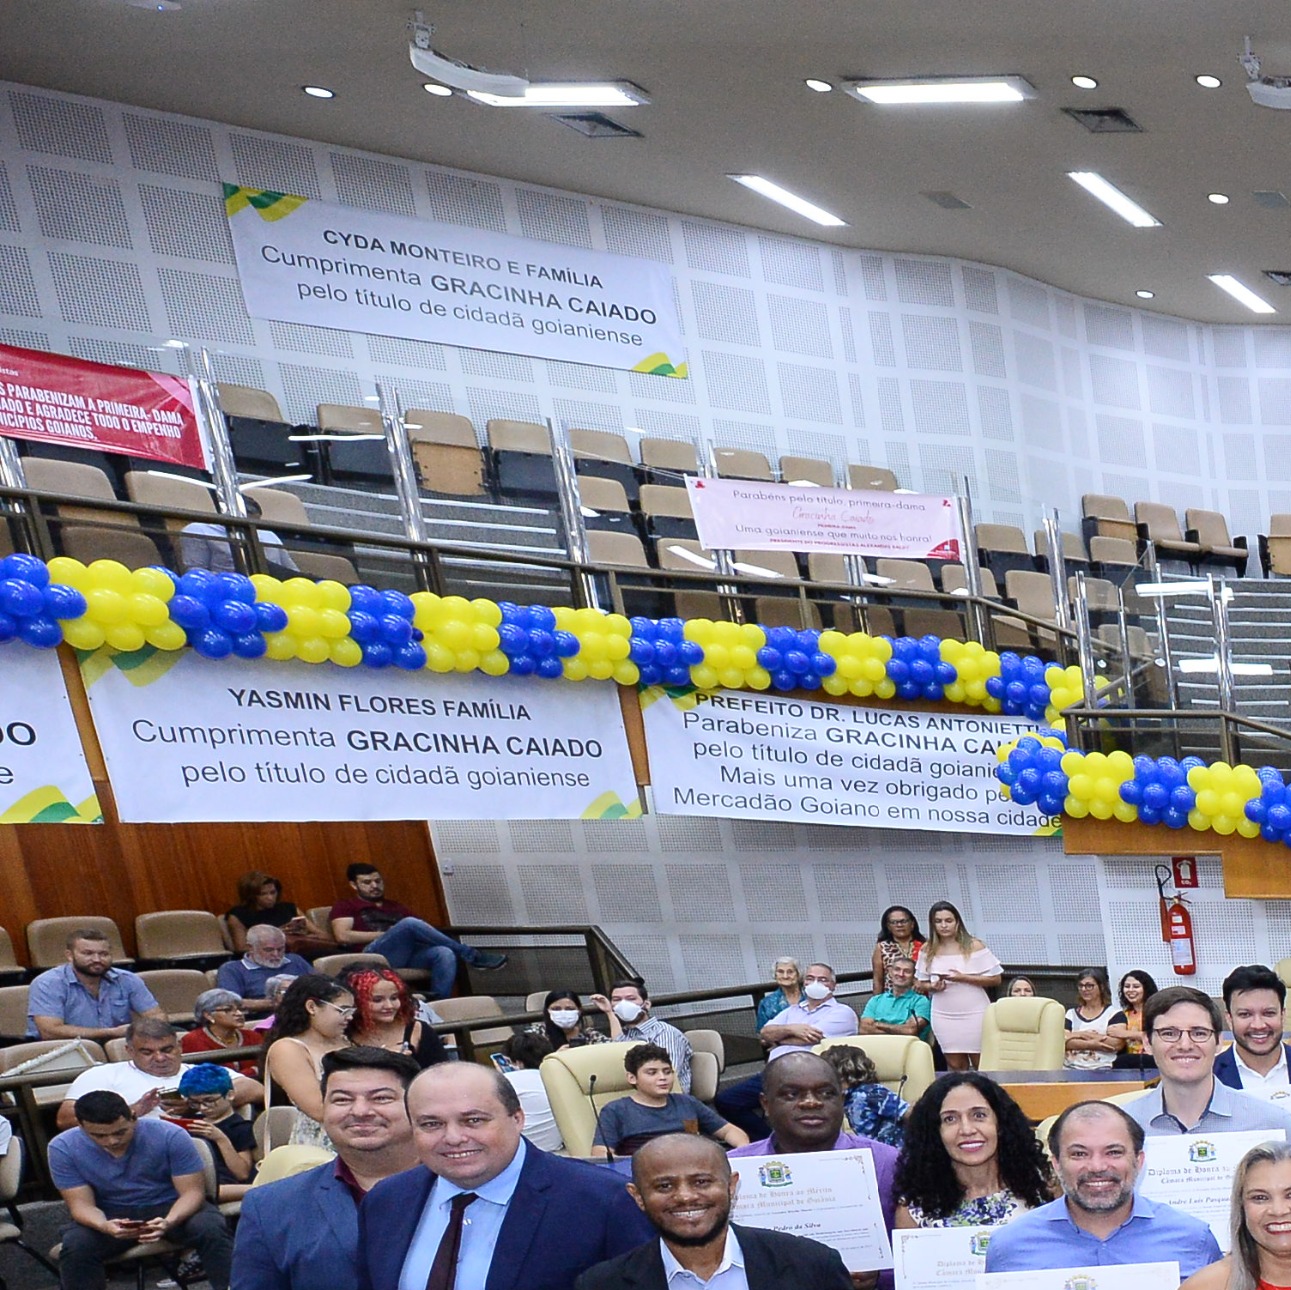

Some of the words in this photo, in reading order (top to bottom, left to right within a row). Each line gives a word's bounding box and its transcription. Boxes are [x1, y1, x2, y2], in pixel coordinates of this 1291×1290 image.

[323, 229, 384, 254] CYDA
[390, 241, 500, 271] MONTEIRO
[508, 261, 521, 275] E
[526, 263, 603, 288] FAMÍLIA
[261, 244, 421, 287] Cumprimenta
[431, 274, 561, 310] GRACINHA
[568, 298, 657, 325] CAIADO
[297, 282, 347, 302] pelo
[355, 289, 411, 311] título
[420, 300, 446, 317] de
[454, 305, 524, 328] cidadã
[532, 317, 642, 346] goianiense
[7, 384, 85, 409] PARABENIZAM
[88, 397, 95, 410] A
[154, 409, 183, 425] DAMA
[26, 403, 33, 415] E
[36, 405, 92, 425] AGRADECE
[93, 413, 120, 430] TODO
[123, 417, 130, 430] O
[132, 419, 181, 439] EMPENHO
[228, 687, 331, 712] YASMIN
[338, 694, 436, 717] FLORES
[443, 698, 531, 721] FAMÍLIA
[695, 692, 804, 718] PREFEITO
[811, 706, 845, 722] DR.
[853, 710, 920, 729] LUCAS
[131, 719, 336, 749] Cumprimenta
[346, 729, 499, 755] GRACINHA
[506, 737, 602, 759] CAIADO
[683, 711, 817, 742] Parabeniza
[826, 727, 956, 753] GRACINHA
[180, 762, 246, 788] pelo
[255, 762, 326, 785] título
[335, 763, 369, 785] de
[376, 764, 459, 786] cidadã
[467, 766, 589, 789] goianiense
[693, 740, 743, 761] pelo
[752, 743, 807, 766] título
[816, 749, 843, 768] de
[851, 754, 921, 774] cidadã
[720, 765, 775, 786] Mais
[784, 775, 832, 791] uma
[840, 778, 879, 794] vez
[885, 780, 979, 802] obrigado
[674, 787, 792, 811] Mercadão
[800, 796, 880, 818] Goiano
[887, 805, 920, 820] em
[928, 807, 990, 825] nossa
